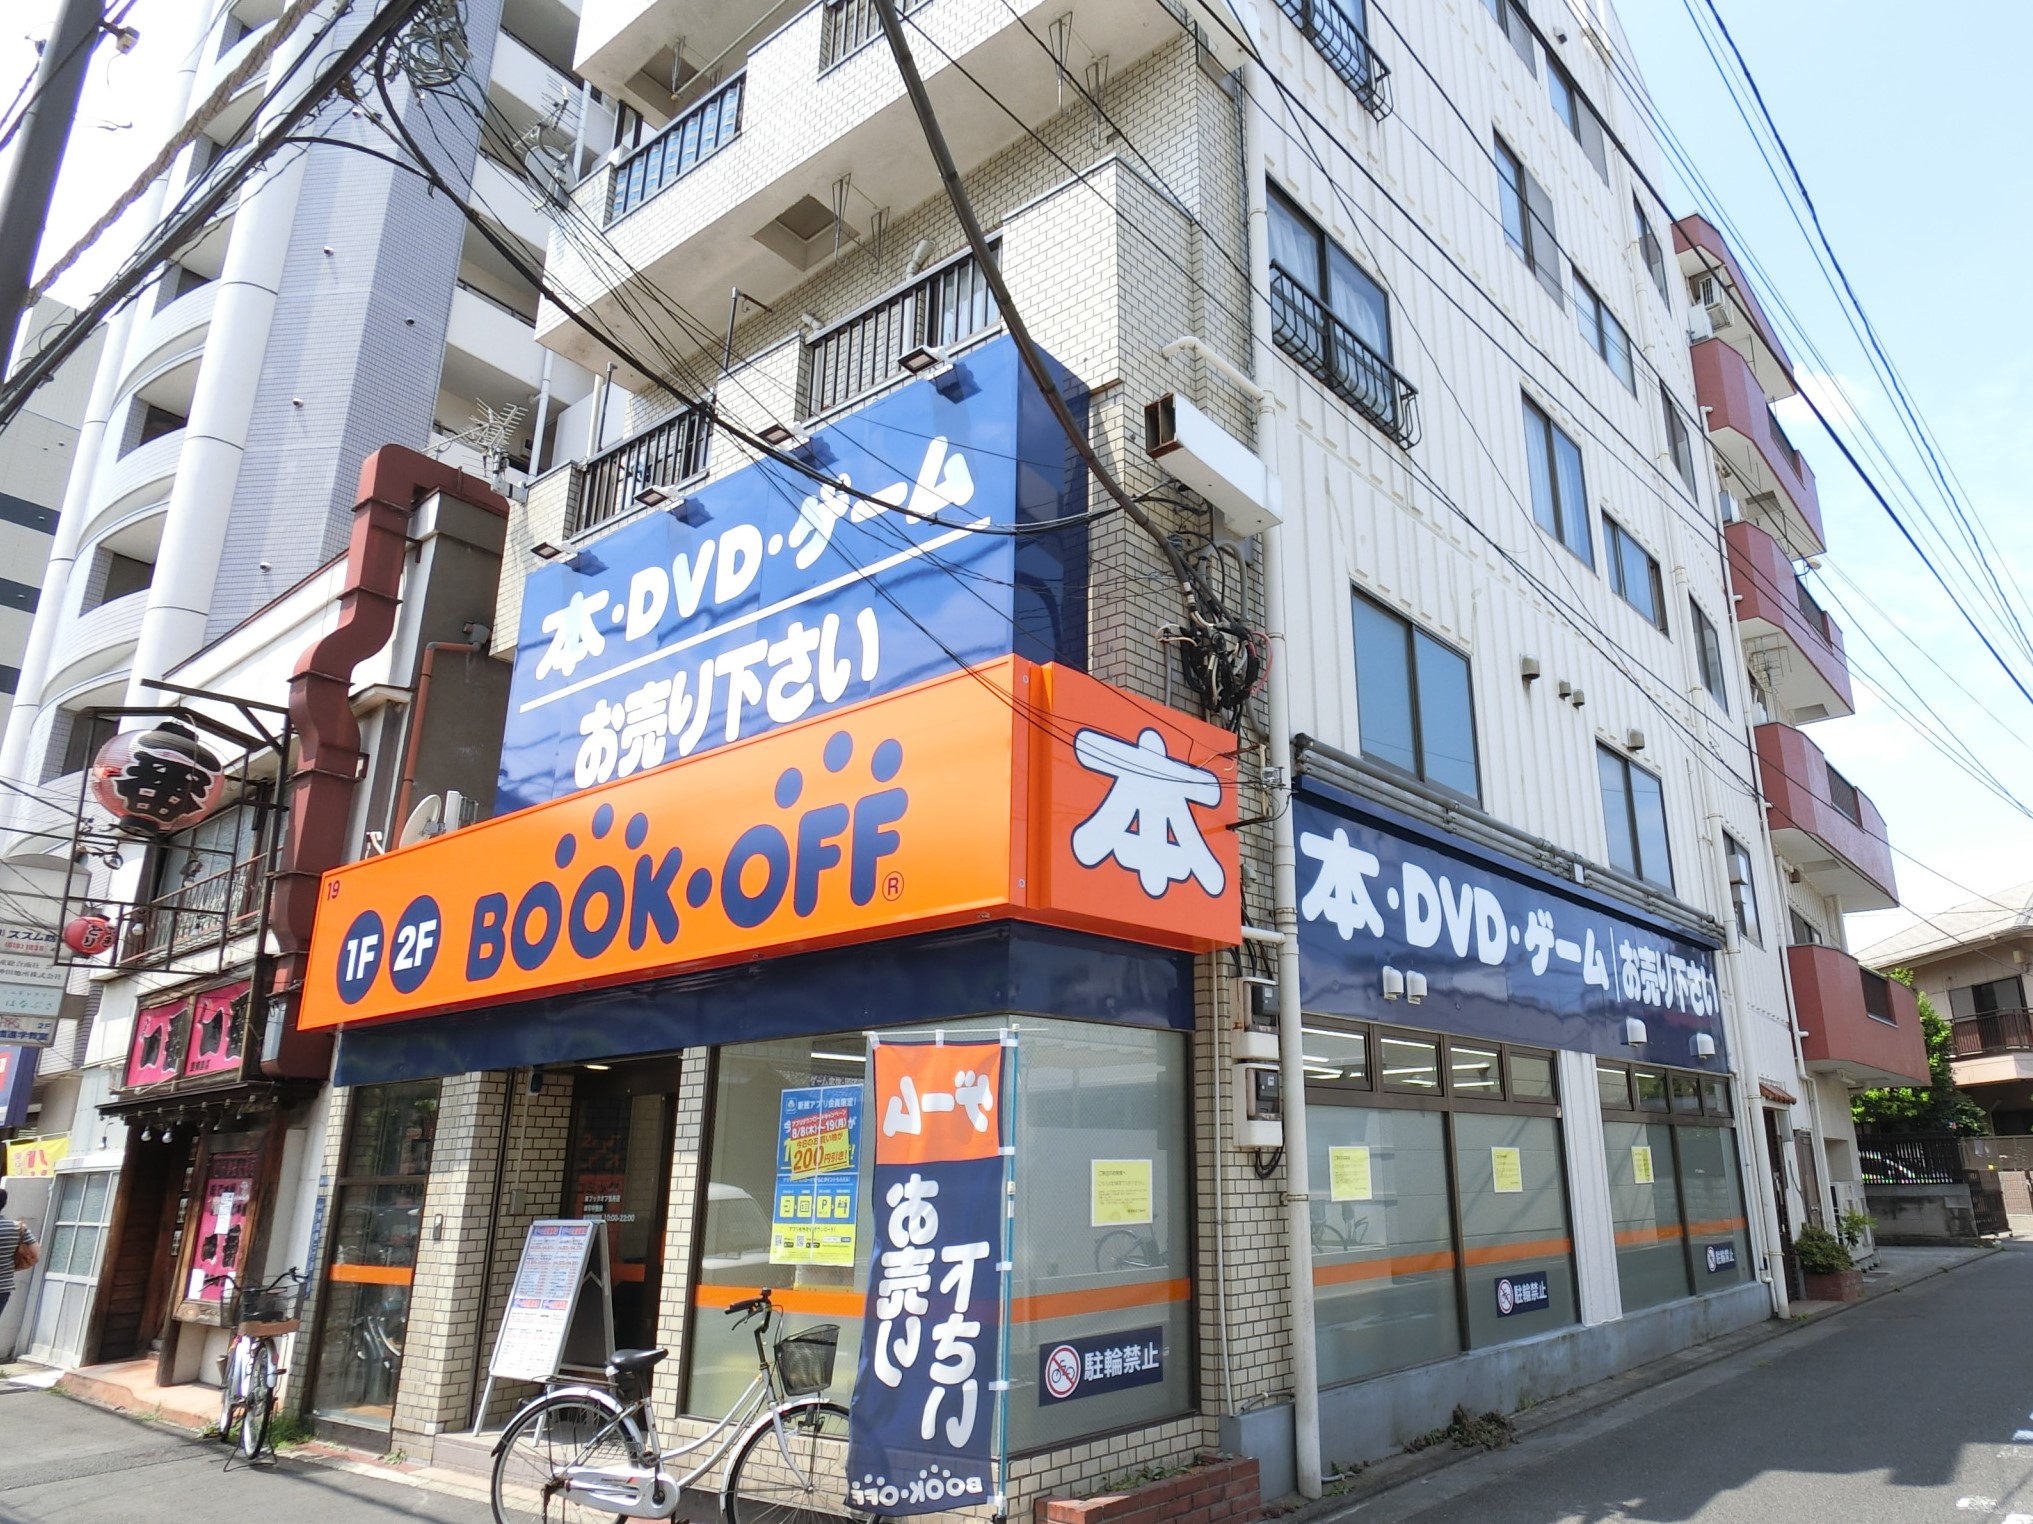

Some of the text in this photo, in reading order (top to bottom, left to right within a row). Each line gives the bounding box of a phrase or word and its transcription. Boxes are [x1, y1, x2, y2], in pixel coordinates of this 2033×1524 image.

[574, 607, 880, 789] お売り下さい
[1071, 726, 1226, 898] 本
[326, 880, 341, 901] 19
[346, 918, 437, 982] 1F 2F
[1619, 938, 1719, 1017] お売り下さい
[1513, 1280, 1548, 1305] 駐輪禁止
[1083, 1342, 1160, 1382] 駐輪禁止
